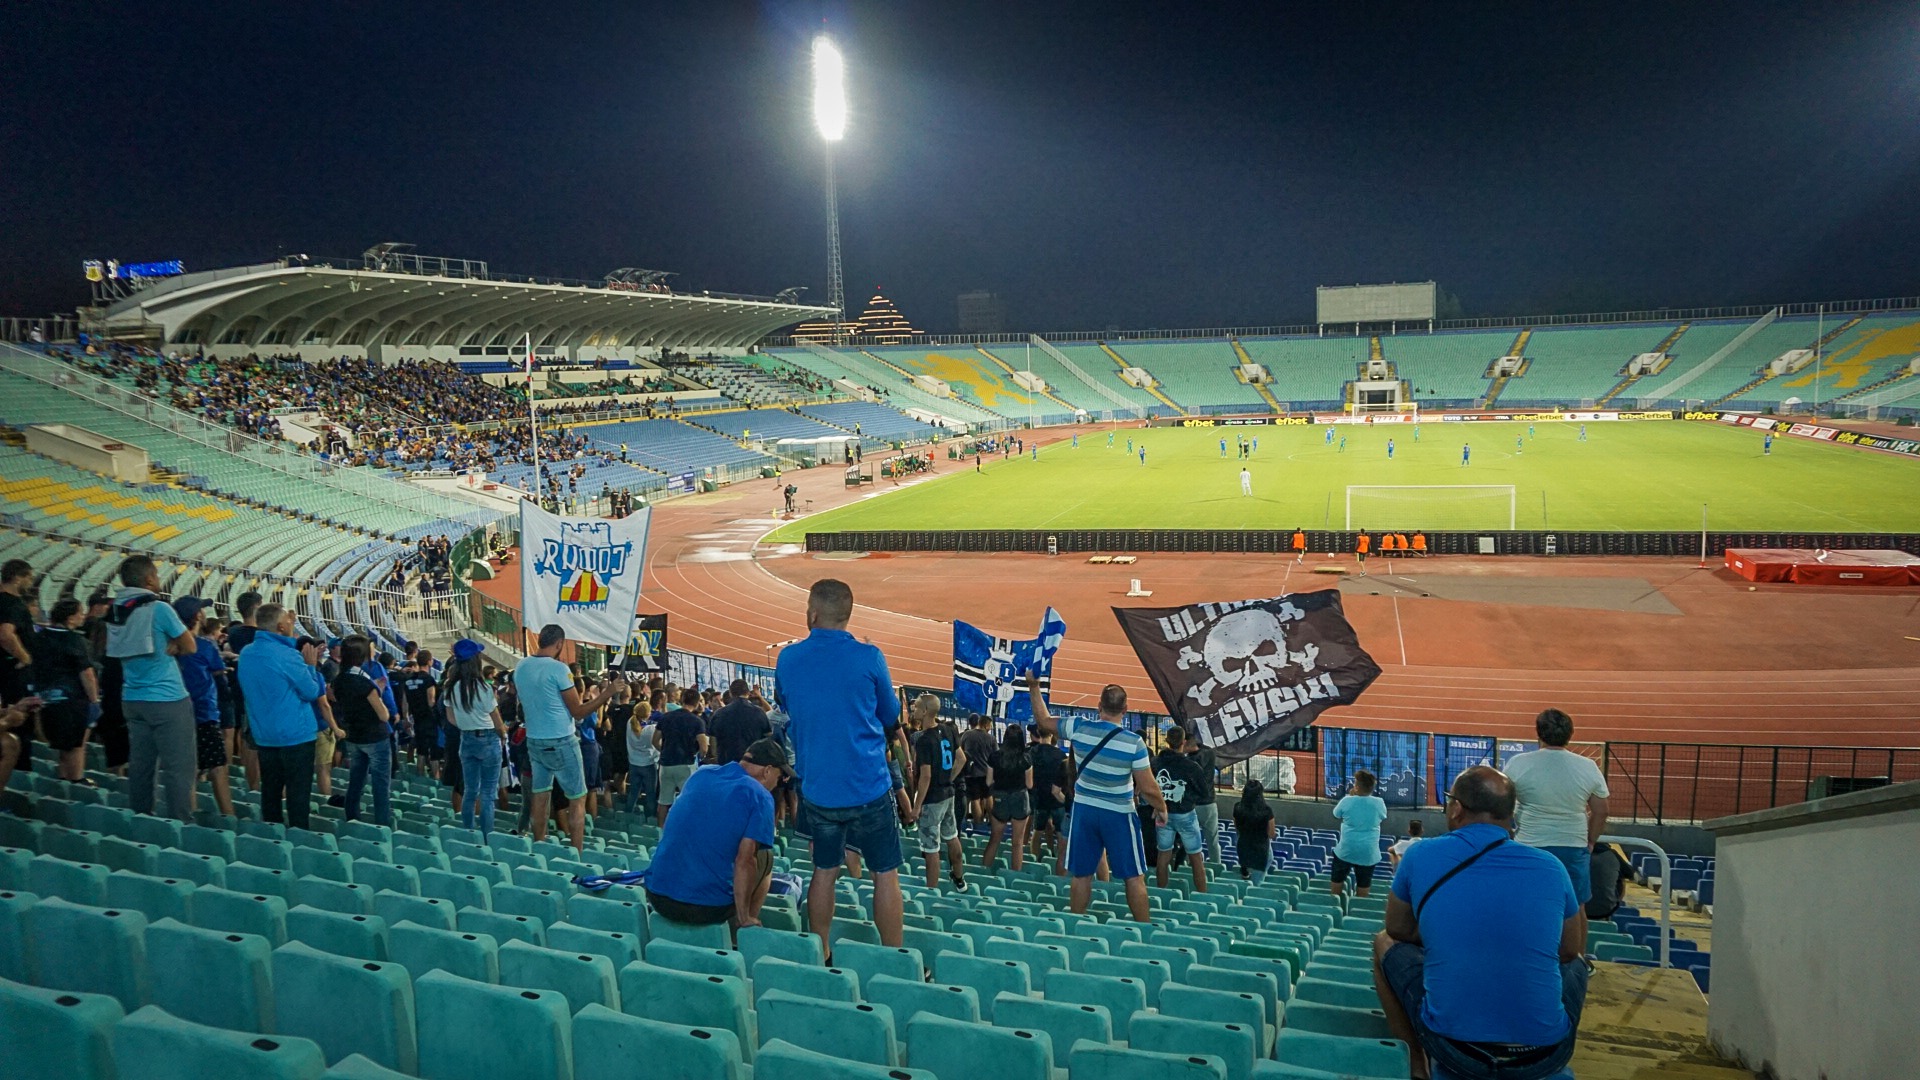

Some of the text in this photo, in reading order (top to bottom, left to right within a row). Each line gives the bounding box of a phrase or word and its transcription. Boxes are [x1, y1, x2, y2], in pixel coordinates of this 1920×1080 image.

[1275, 417, 1308, 425] efbet
[1684, 412, 1719, 420] efbet
[1183, 419, 1215, 428] efbet
[1836, 432, 1859, 444] efbet
[1193, 671, 1340, 748] LEVSKI
[940, 738, 953, 771] 6
